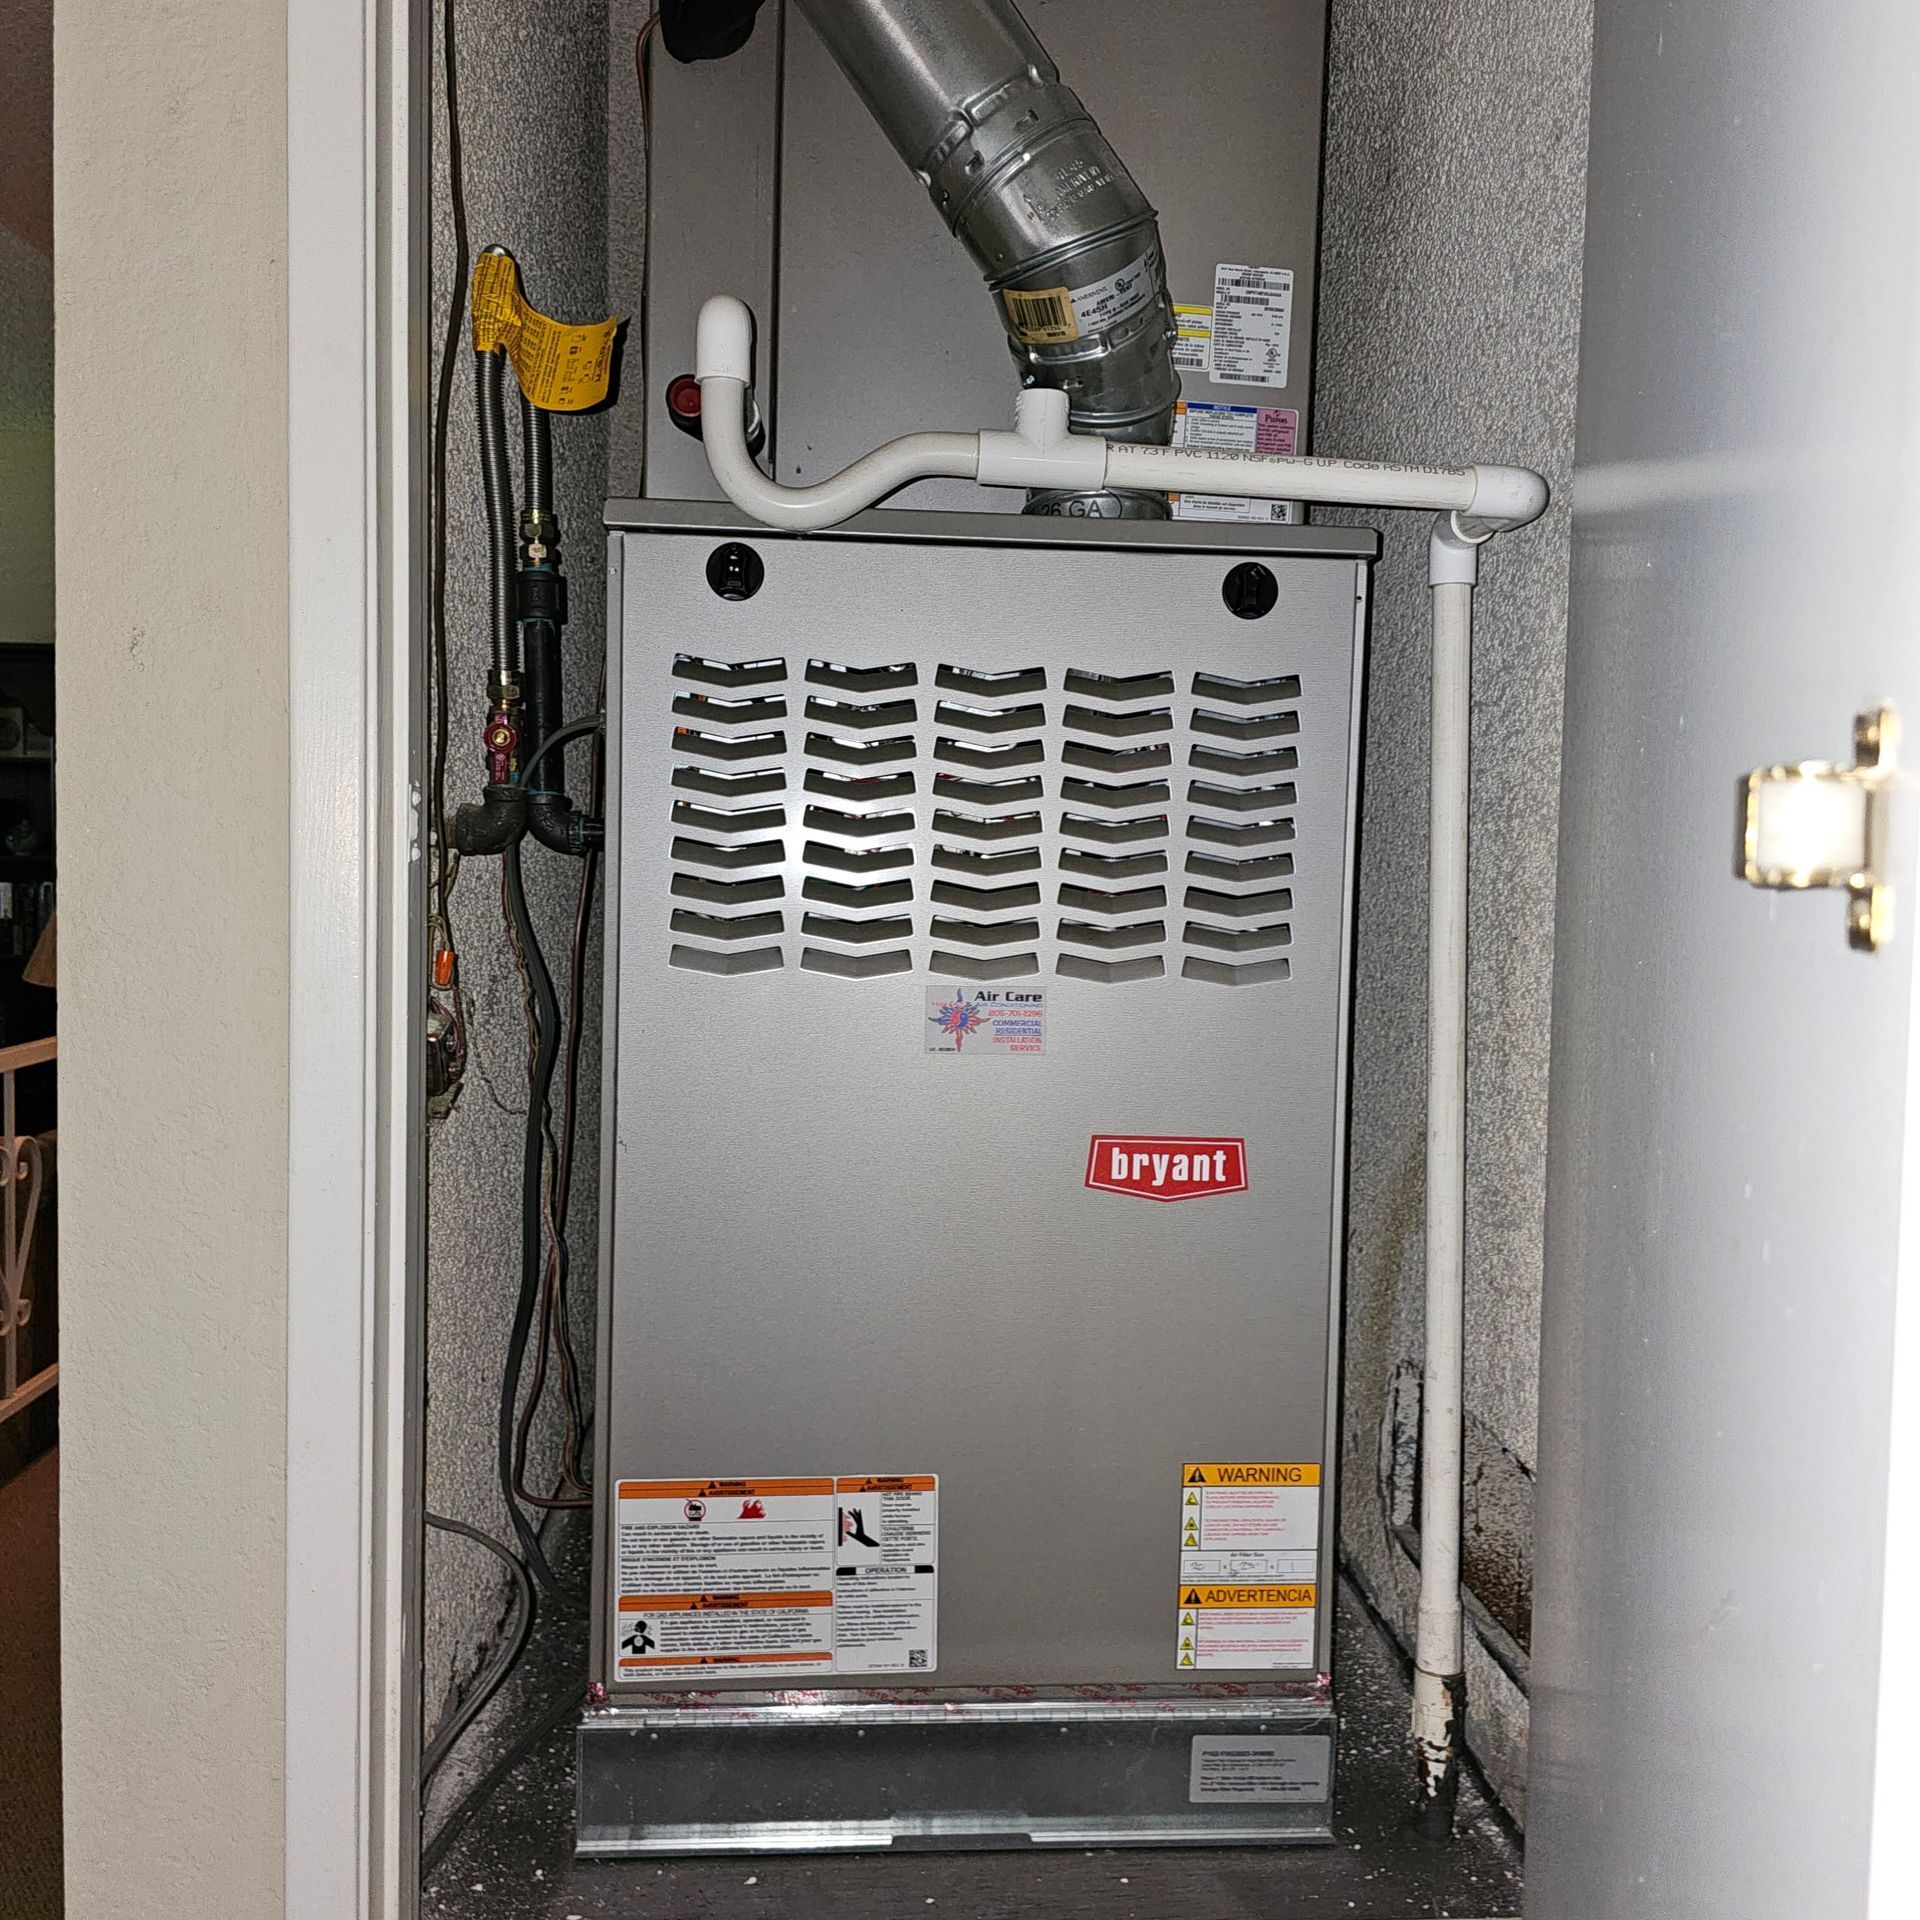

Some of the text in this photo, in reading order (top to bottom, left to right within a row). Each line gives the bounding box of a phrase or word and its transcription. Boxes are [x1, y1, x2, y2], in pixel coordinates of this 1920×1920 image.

[1118, 445, 1137, 454] AT
[1175, 448, 1202, 458] PVC
[1207, 451, 1239, 461] 1120
[1344, 460, 1379, 471] Code
[1383, 463, 1419, 473] ASTM
[1069, 500, 1103, 518] GA
[974, 991, 1043, 1002] Air Care
[992, 1019, 1042, 1027] COMMERCIAL
[995, 1027, 1042, 1035] RESIDENTIAL
[1009, 1044, 1042, 1052] SERVICE
[1111, 1147, 1226, 1187] bryant
[1218, 1467, 1302, 1482] WARNING
[1205, 1589, 1313, 1602] ADVERTENCIA
